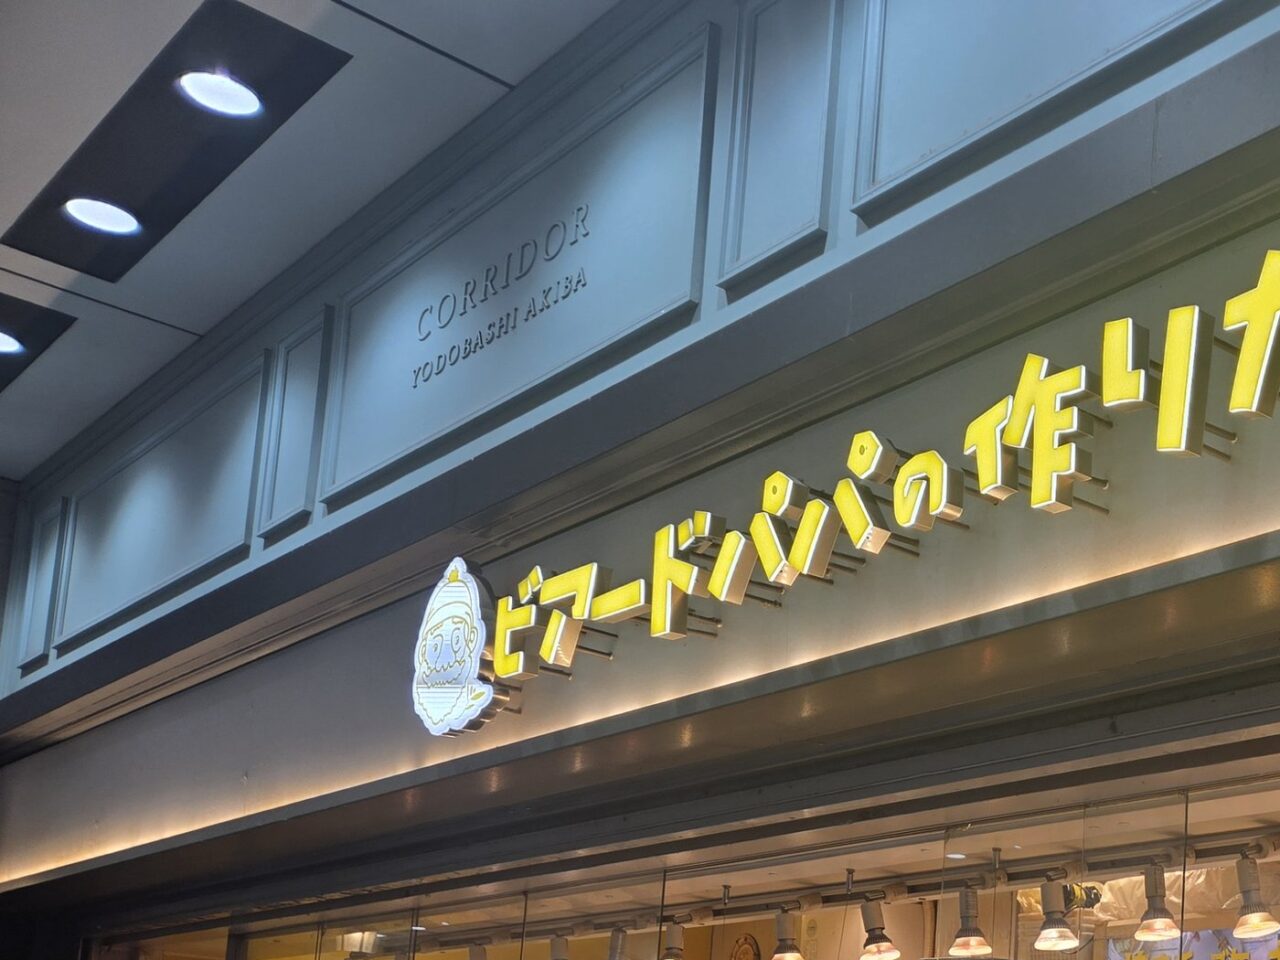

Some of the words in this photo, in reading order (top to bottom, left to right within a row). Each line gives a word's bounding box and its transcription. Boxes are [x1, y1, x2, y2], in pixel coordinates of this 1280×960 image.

[410, 304, 519, 389] YODOBASHI
[523, 266, 588, 322] AKIBA
[416, 203, 590, 343] CORRIDOR
